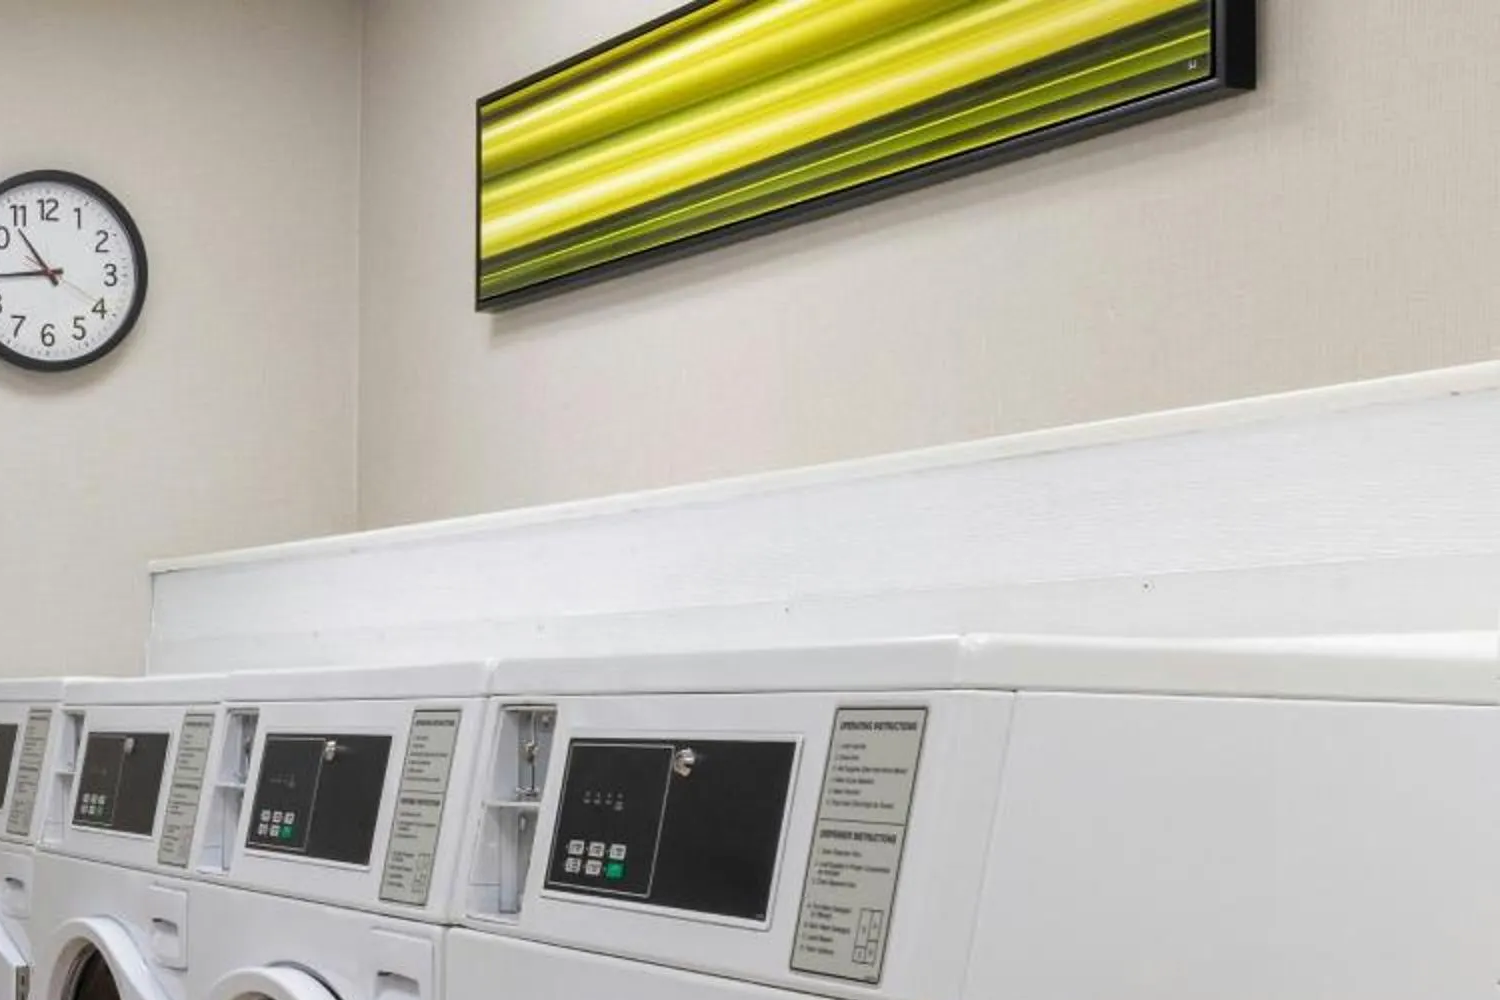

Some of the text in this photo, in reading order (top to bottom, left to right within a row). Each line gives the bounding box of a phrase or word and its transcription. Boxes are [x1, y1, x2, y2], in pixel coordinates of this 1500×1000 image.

[10, 204, 26, 227] 11
[37, 198, 59, 222] 12
[74, 208, 81, 229] 1
[95, 230, 109, 253] 2
[104, 264, 118, 287] 3
[92, 298, 107, 319] 4
[11, 315, 26, 338] 7
[41, 324, 55, 347] 6
[72, 316, 86, 340] 5
